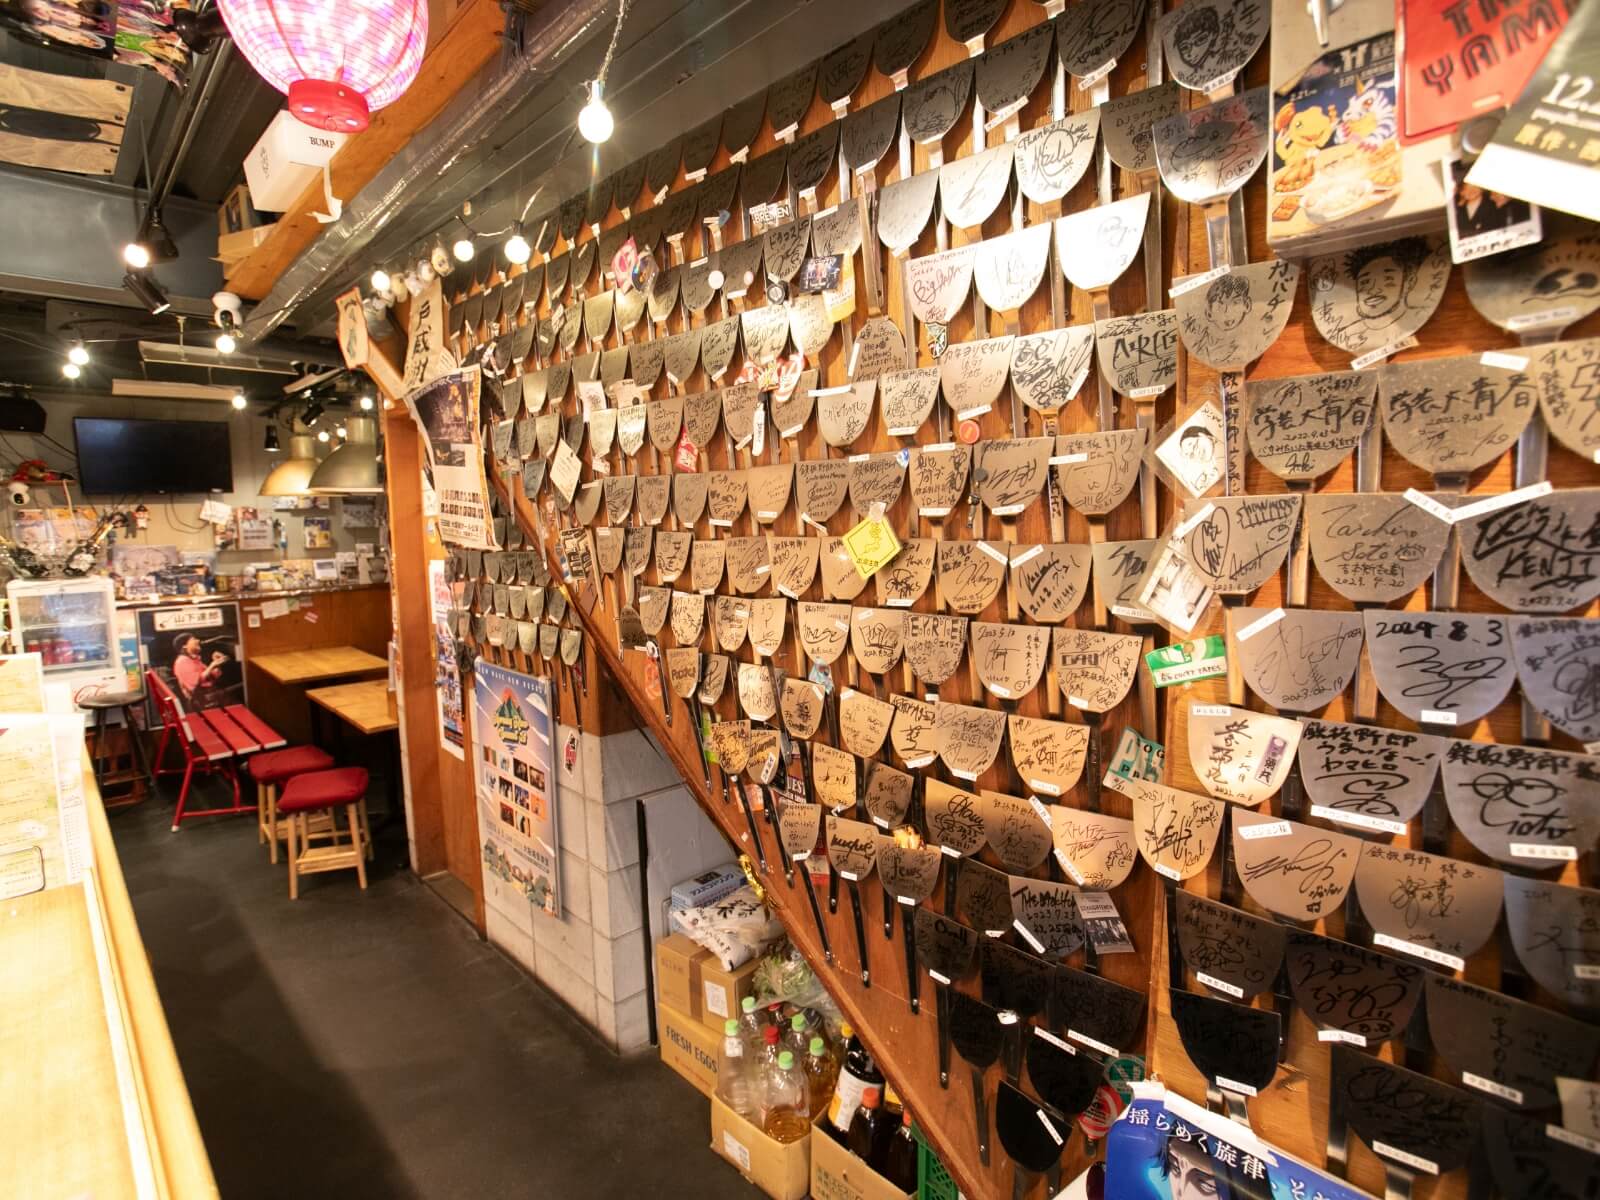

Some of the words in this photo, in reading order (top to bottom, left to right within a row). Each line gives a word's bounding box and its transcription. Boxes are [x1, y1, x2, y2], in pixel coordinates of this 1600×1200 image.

[309, 136, 335, 149] BUMP
[666, 1025, 692, 1055] FRESH
[695, 1046, 717, 1073] EGGS
